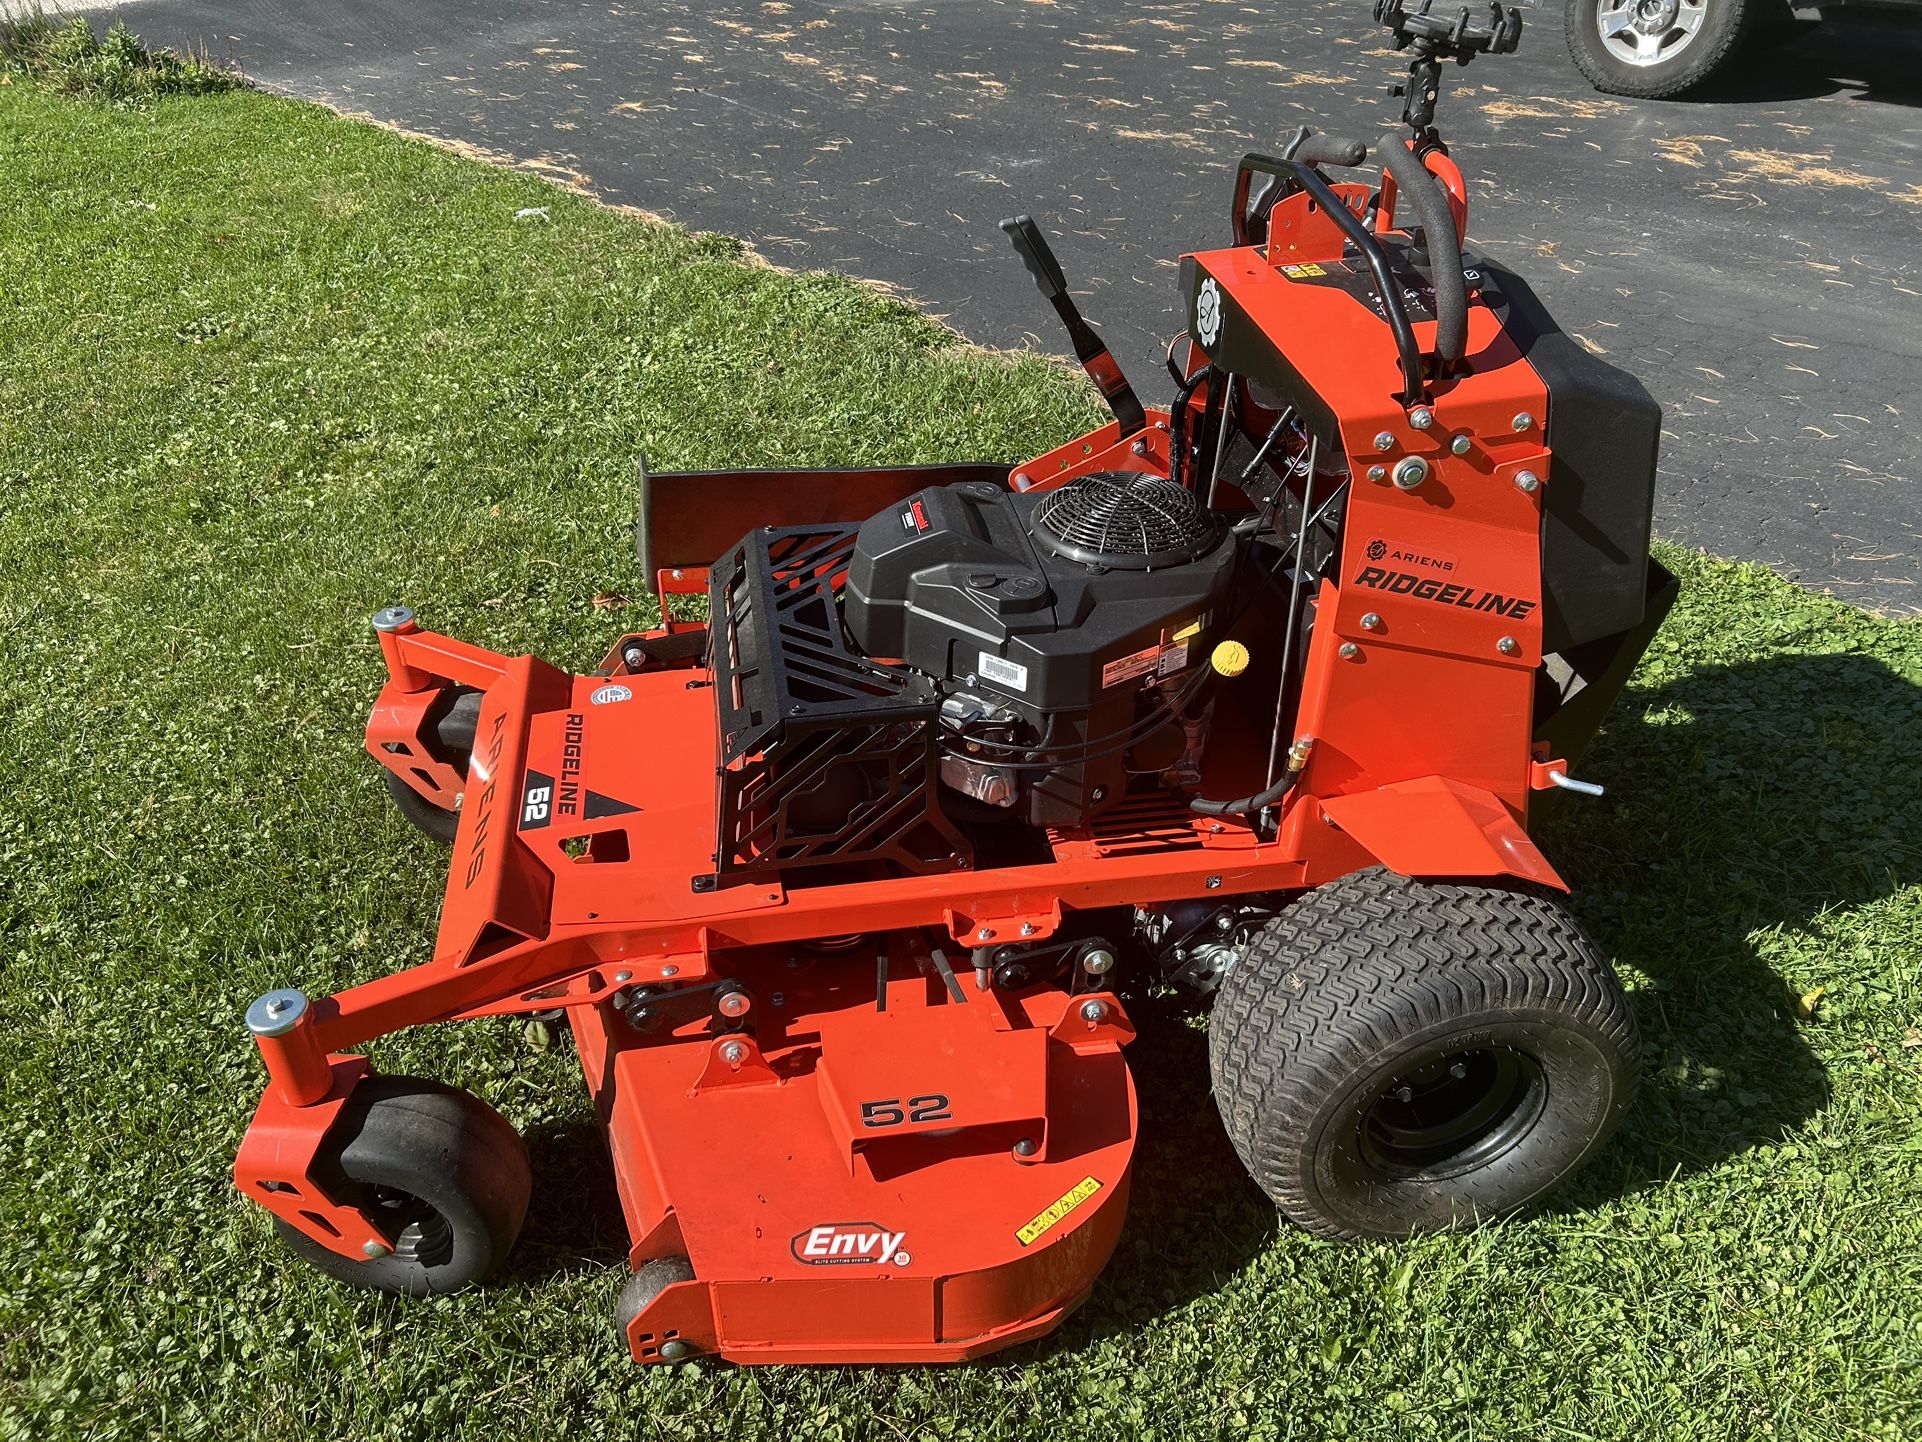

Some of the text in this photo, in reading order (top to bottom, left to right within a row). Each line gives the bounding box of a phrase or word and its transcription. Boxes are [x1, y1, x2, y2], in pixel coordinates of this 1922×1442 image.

[1391, 550, 1454, 571] ARIENS
[1354, 566, 1537, 620] RIDGELINE
[558, 713, 584, 816] RIDGELINE
[465, 712, 507, 890] ARIENS
[524, 786, 550, 822] 52
[860, 1094, 953, 1128] 52
[803, 1227, 906, 1264] Envy
